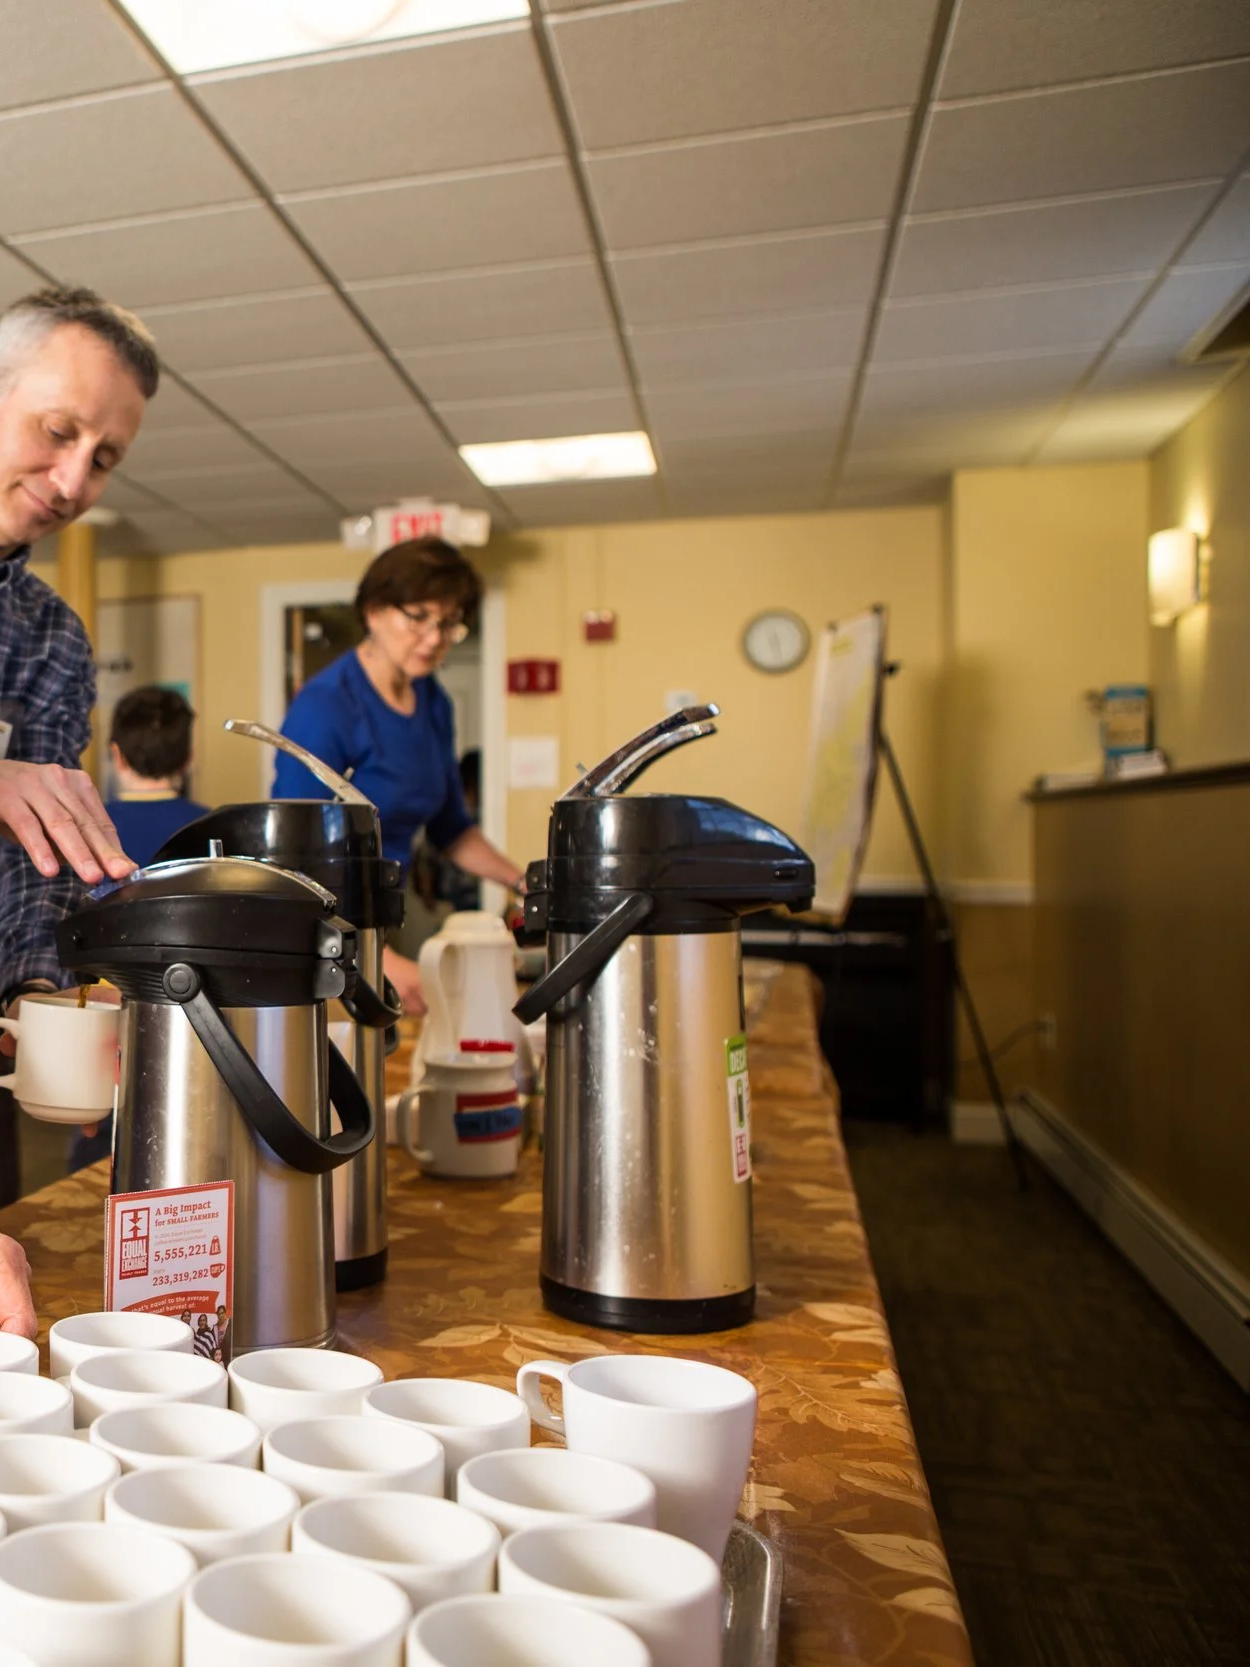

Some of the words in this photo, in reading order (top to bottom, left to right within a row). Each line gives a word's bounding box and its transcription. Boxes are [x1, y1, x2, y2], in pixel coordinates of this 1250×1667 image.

[155, 1208, 161, 1216] A
[163, 1204, 178, 1217] Big
[180, 1200, 211, 1214] Impact
[155, 1219, 165, 1227] for
[167, 1216, 188, 1225] SMALL
[190, 1212, 219, 1222] FARMERS
[122, 1239, 147, 1260] EQUAL
[154, 1244, 207, 1263] 5,555,221
[121, 1256, 147, 1272] EXCHANGE
[152, 1268, 209, 1286] 233,319,282
[150, 1298, 167, 1308] equal
[175, 1296, 186, 1304] the
[187, 1295, 210, 1303] average
[166, 1302, 187, 1312] harvest
